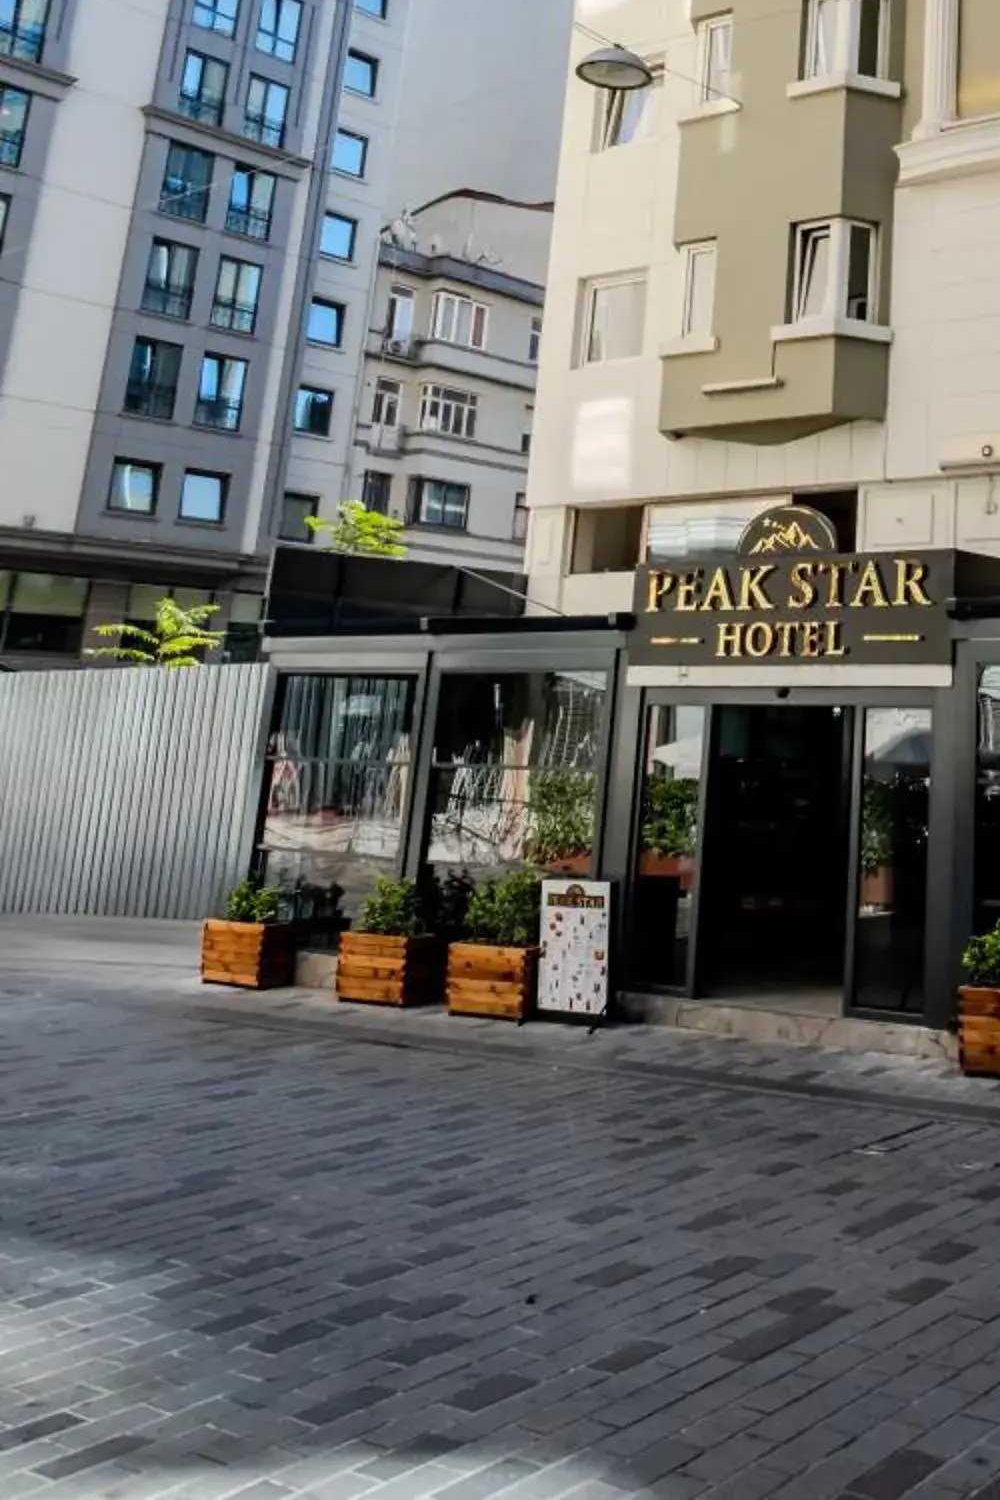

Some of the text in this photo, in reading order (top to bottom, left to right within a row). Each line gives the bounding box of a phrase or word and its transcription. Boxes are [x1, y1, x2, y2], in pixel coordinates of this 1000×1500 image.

[644, 558, 934, 613] PEAK STAR
[714, 619, 847, 657] HOTEL
